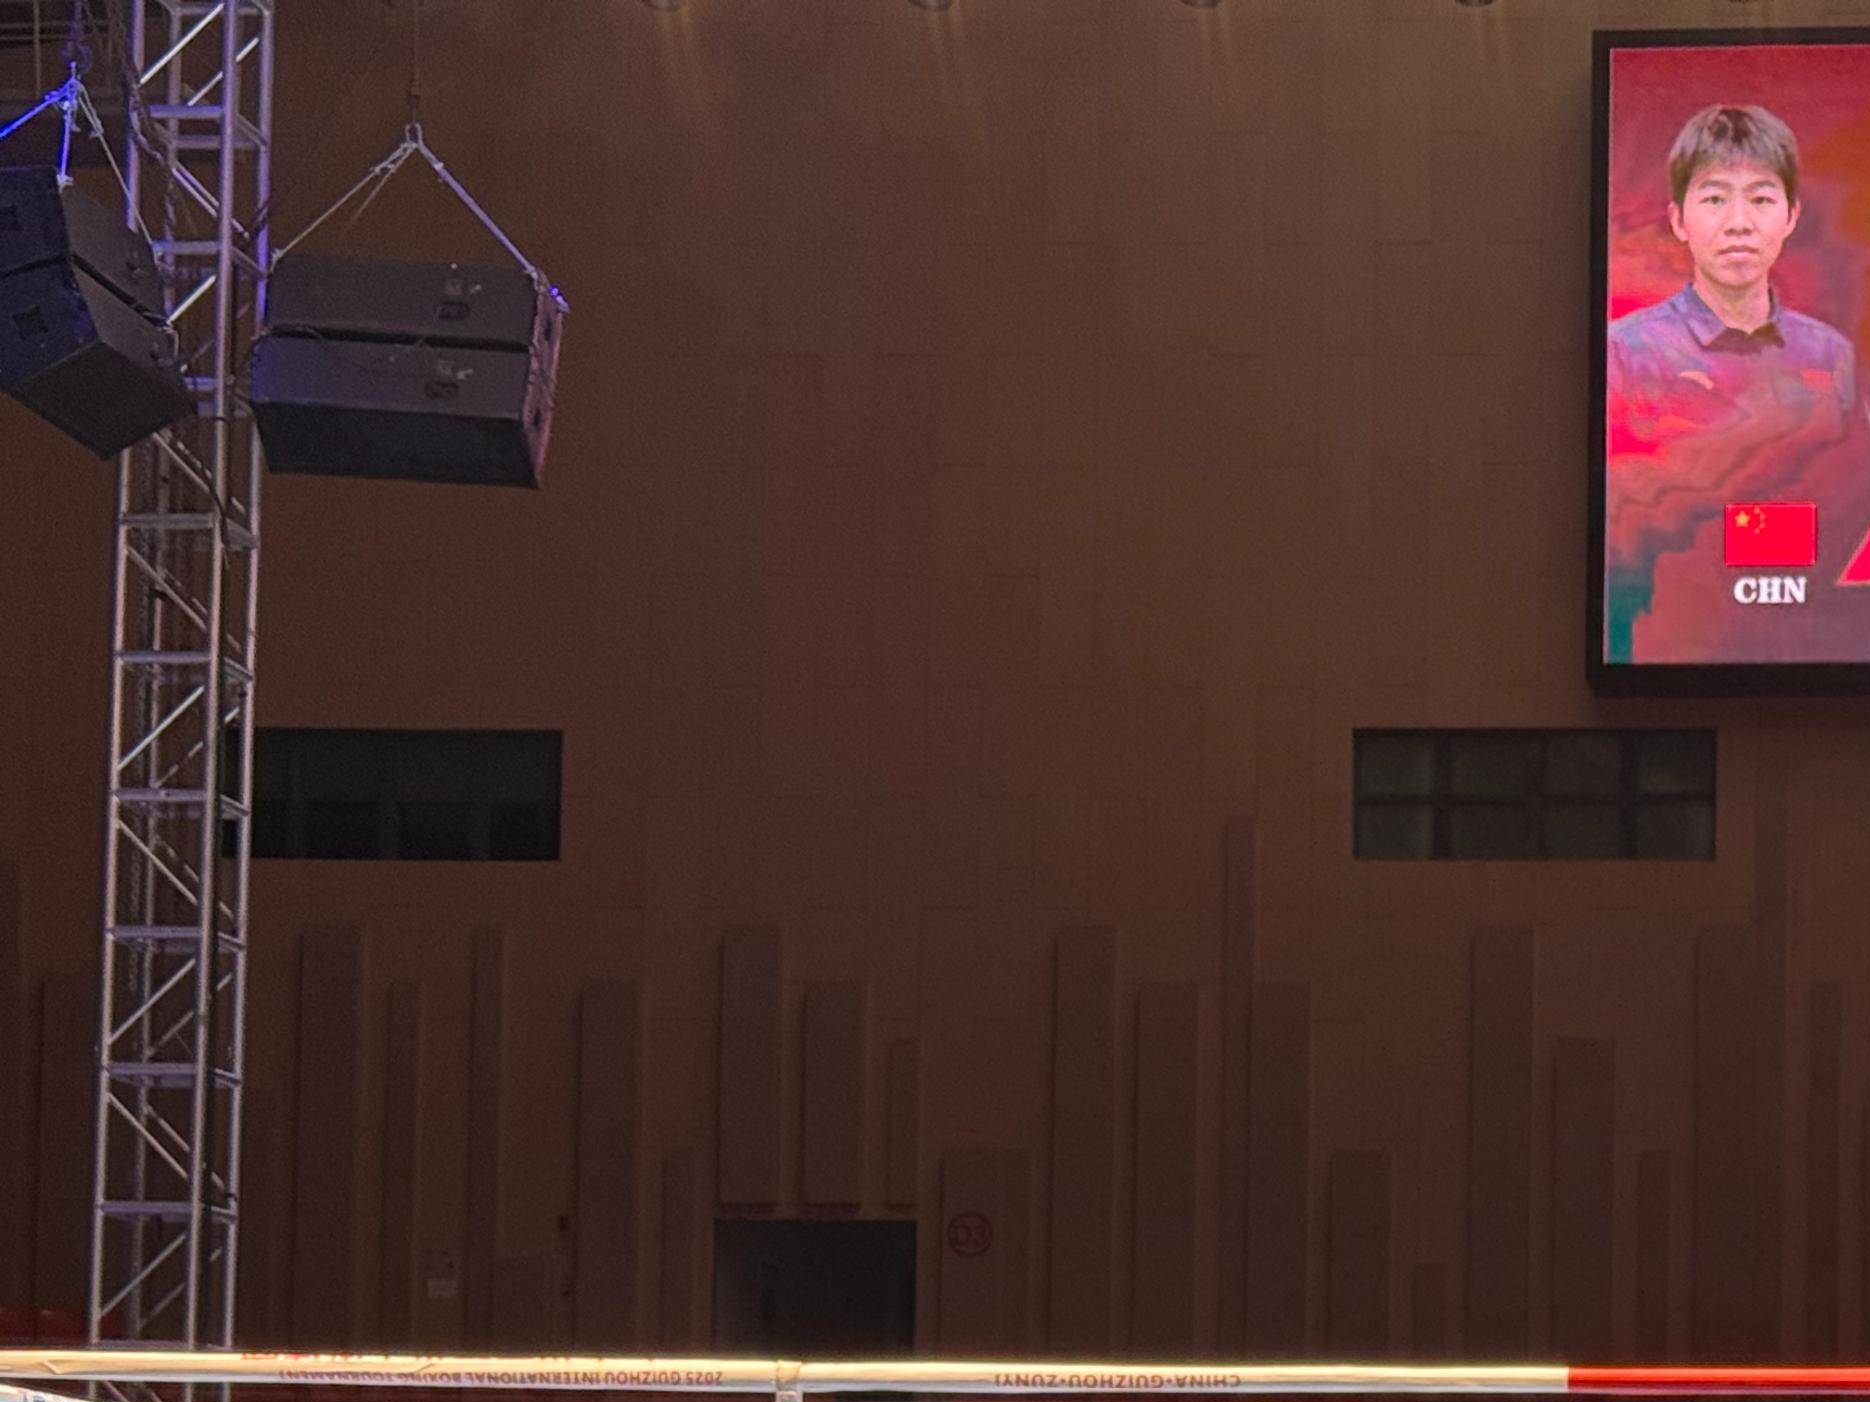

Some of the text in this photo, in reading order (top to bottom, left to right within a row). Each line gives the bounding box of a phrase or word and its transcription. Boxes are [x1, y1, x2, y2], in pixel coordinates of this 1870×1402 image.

[1734, 577, 1807, 604] CHN
[466, 1371, 597, 1385] INTERNATIONAL
[605, 1372, 678, 1385] GUIZHOU
[680, 1372, 723, 1385] 2025
